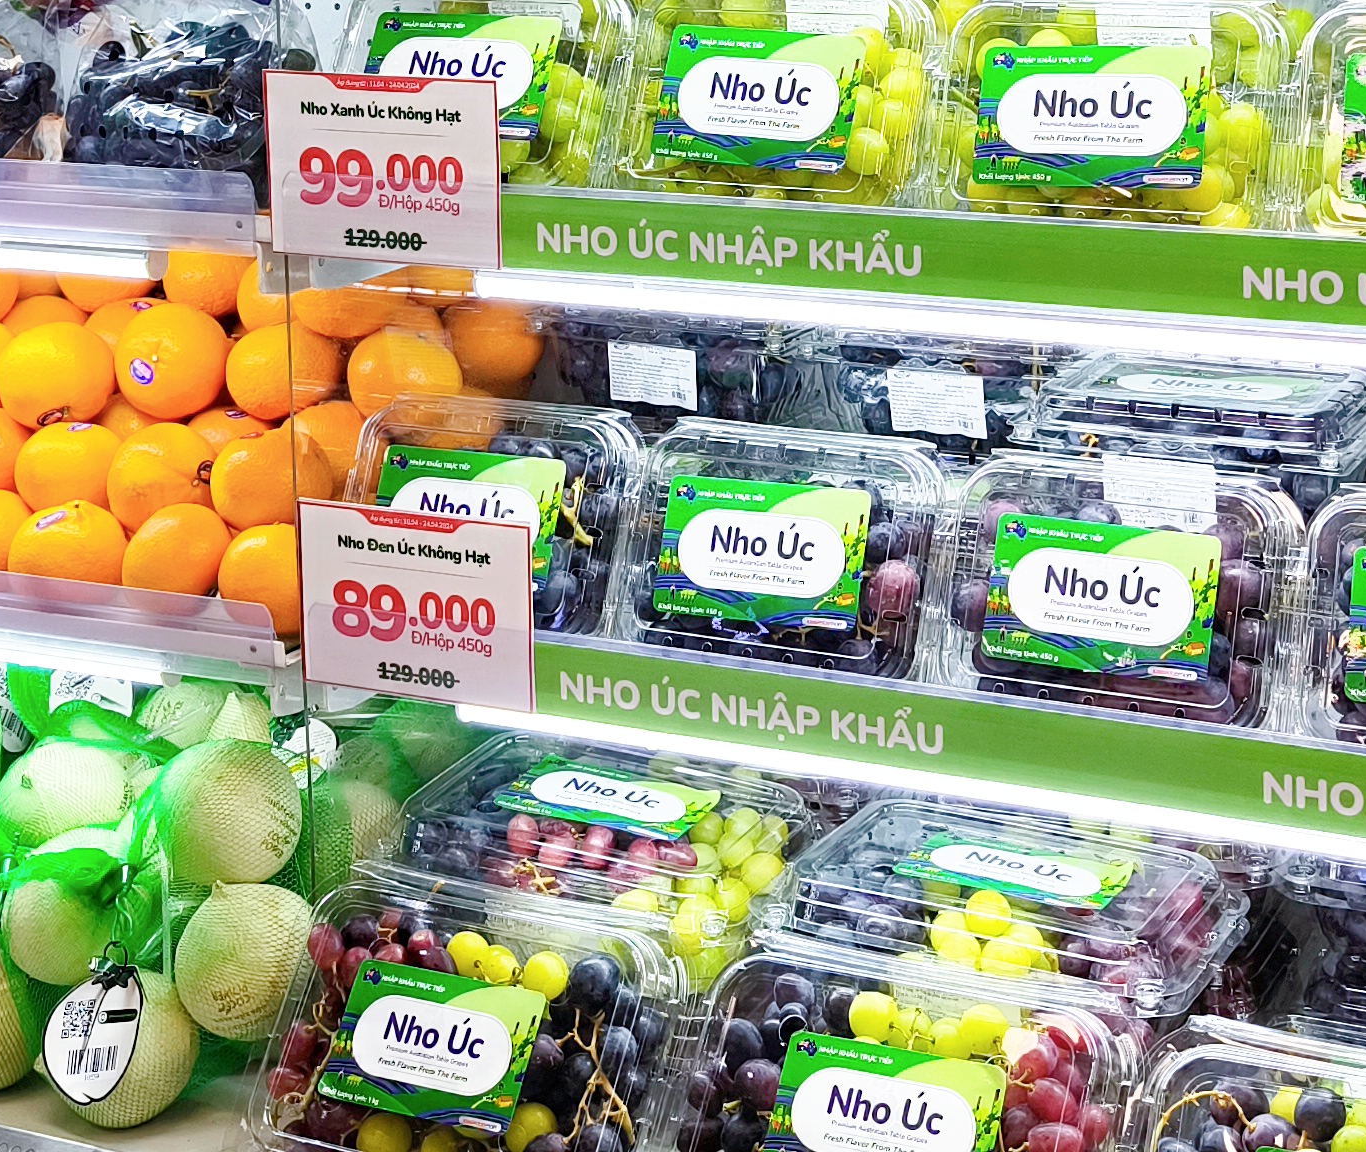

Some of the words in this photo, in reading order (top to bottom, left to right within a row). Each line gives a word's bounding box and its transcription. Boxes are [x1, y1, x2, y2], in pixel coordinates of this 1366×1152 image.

[710, 72, 765, 102] Nho
[775, 69, 811, 106] Úc
[1034, 90, 1098, 117] Nho
[1111, 82, 1152, 119] Úc
[300, 101, 327, 115] Nho
[331, 102, 364, 117] Xanh
[368, 101, 385, 118] Úc
[388, 106, 432, 124] Không
[435, 108, 461, 126] Hạt
[299, 146, 463, 208] 99.000
[378, 194, 422, 213] Đ/Hộp
[425, 197, 460, 216] 450g
[344, 228, 427, 251] 129.000
[537, 223, 617, 256] NHO
[629, 219, 678, 260] ÚC
[690, 226, 797, 275] NHẬP
[809, 230, 921, 276] KHẨU
[1243, 266, 1343, 304] NHO
[337, 534, 364, 550] Nho
[367, 538, 394, 553] Đen
[398, 538, 415, 556] Úc
[418, 543, 461, 564] Không
[465, 550, 491, 567] Hạt
[711, 525, 767, 556] Nho
[778, 523, 814, 561] Úc
[1045, 565, 1108, 600] Nho
[1120, 567, 1160, 607] Úc
[332, 579, 495, 642] 89.000
[411, 631, 454, 652] Đ/Hộp
[458, 638, 492, 657] 450g
[377, 661, 460, 688] 129.000
[559, 670, 640, 712] NHO
[651, 674, 701, 722] ÚC
[711, 692, 822, 741] NHẬP
[829, 705, 945, 756] KHẨU
[1263, 772, 1364, 816] NHO
[384, 1012, 439, 1048] Nho
[448, 1018, 484, 1058] Úc
[827, 1085, 891, 1124] Nho
[902, 1092, 943, 1135] Úc
